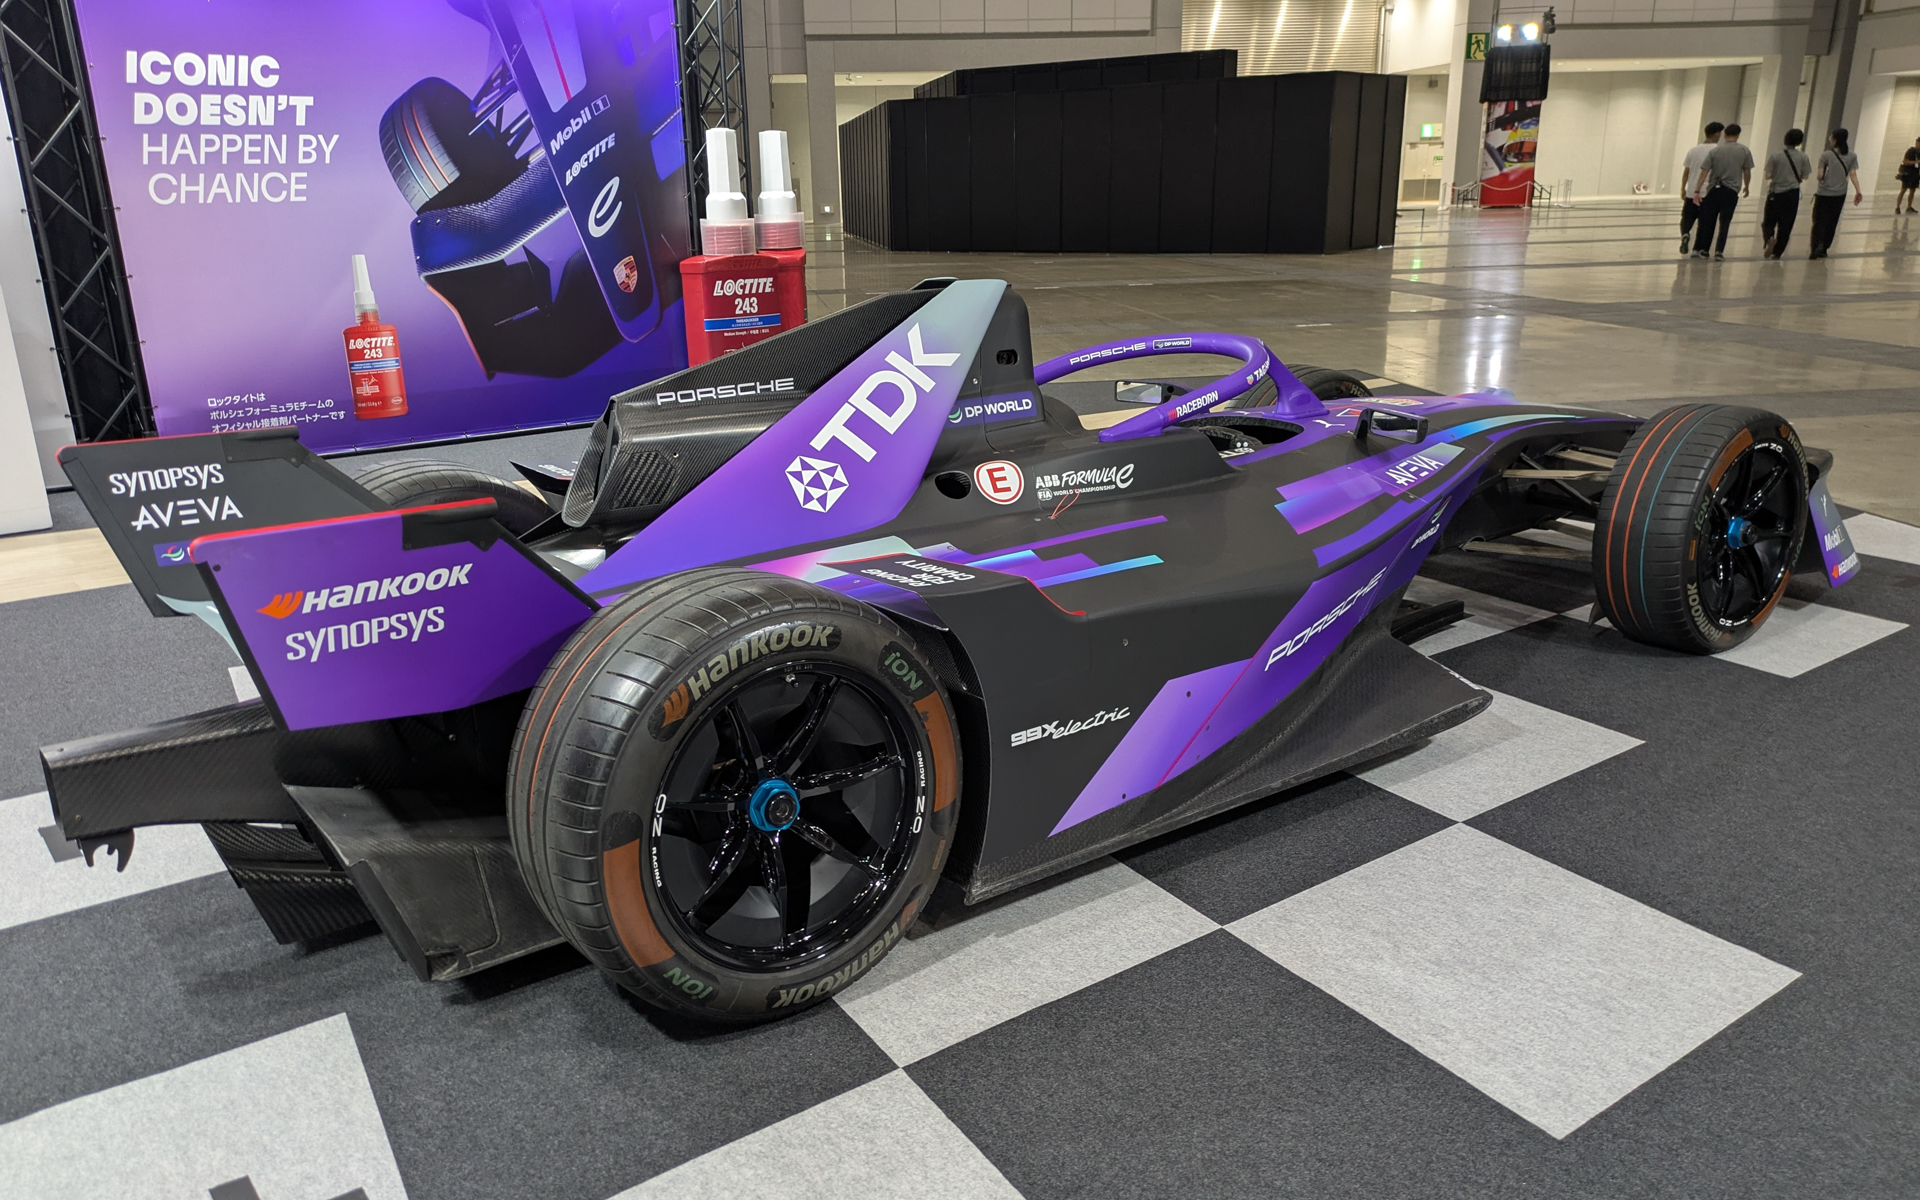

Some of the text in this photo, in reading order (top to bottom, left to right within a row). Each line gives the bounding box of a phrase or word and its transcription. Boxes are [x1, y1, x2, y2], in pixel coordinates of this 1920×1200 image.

[125, 50, 280, 88] ICONIC
[550, 106, 592, 156] Mobil
[142, 133, 339, 165] HAPPEN BY
[565, 132, 616, 187] LOCTITE
[148, 171, 308, 205] CHANCE
[713, 277, 774, 296] LOCTITE
[734, 297, 758, 314] 243
[348, 336, 394, 349] LOCTITE
[363, 348, 383, 359] 243
[1069, 342, 1146, 366] PORSCHE
[207, 392, 266, 407] ロックタイトは
[655, 377, 795, 406] PORSCHE
[808, 322, 962, 463] TDK
[1175, 390, 1219, 418] RACEBORN
[209, 398, 334, 420] ポルシェフォーミュラEチームの
[964, 398, 1033, 418] DP WORLD
[108, 463, 225, 498] SYNOPSYS
[986, 466, 1012, 494] E
[1036, 474, 1061, 489] ABB
[1061, 465, 1117, 488] FORMULA
[1385, 454, 1445, 487] AVEVA
[1053, 488, 1074, 497] WORLD
[1074, 484, 1116, 494] CHAMPIONSHIP
[131, 495, 243, 531] AVEVA
[1264, 566, 1387, 671] PORSCHE
[285, 606, 445, 663] SYNOPSYS
[916, 750, 926, 787] RACING
[651, 846, 663, 888] RACING
